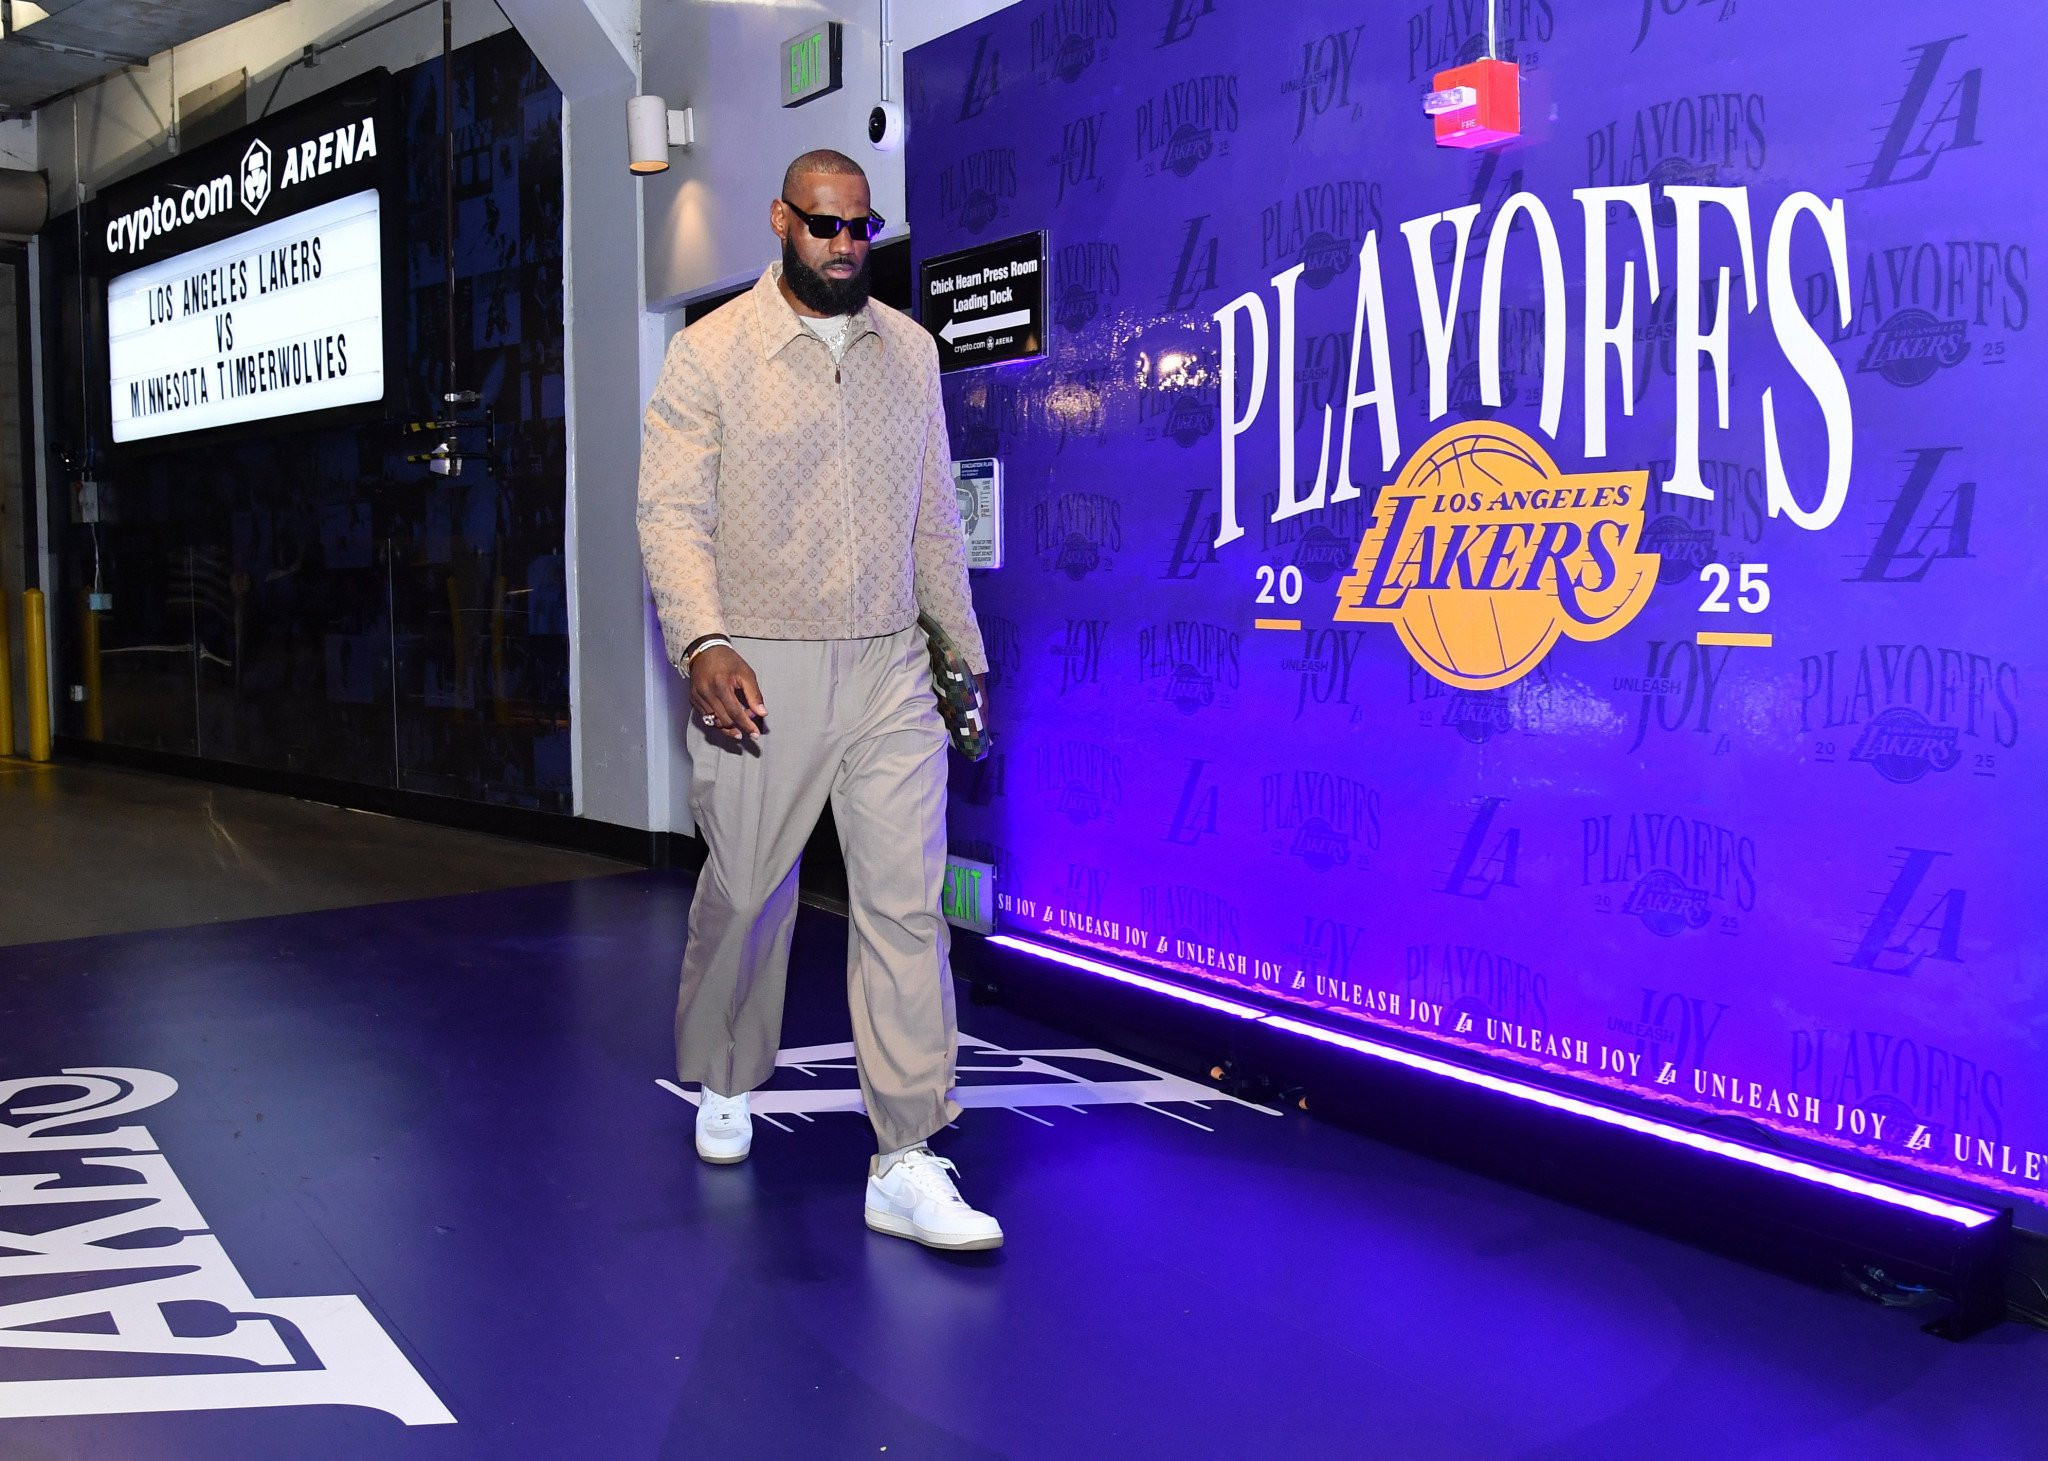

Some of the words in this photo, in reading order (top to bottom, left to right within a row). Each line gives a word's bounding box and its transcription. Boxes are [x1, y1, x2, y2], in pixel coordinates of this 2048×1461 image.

[790, 32, 821, 95] EXIT
[1291, 25, 1366, 145] JOY
[1136, 74, 1240, 162] PLAYOFFS
[1461, 118, 1477, 130] FIRE
[1846, 33, 1985, 193] LA
[107, 174, 233, 254] crypto.com
[280, 117, 377, 190] ARENA
[149, 284, 173, 326] LOS
[183, 260, 248, 317] ANGELES
[259, 236, 322, 295] LAKERS
[930, 277, 955, 296] Chick
[955, 272, 982, 290] Hearn
[983, 266, 1009, 284] Press
[1010, 259, 1038, 278] Room
[953, 294, 989, 314] Loading
[990, 286, 1013, 306] Dock
[1157, 214, 1220, 316] LA
[215, 311, 233, 353] VS
[954, 341, 986, 354] crypto.com
[995, 336, 1013, 346] ARENA
[1213, 182, 1854, 549] PLAYOFFS
[1864, 329, 1962, 368] LAKERS
[1983, 341, 2005, 357] 25
[130, 366, 209, 418] MINNESOTA
[217, 333, 347, 400] TIMBERWOLVES
[1158, 488, 1220, 580] LA
[1432, 492, 1484, 514] LOS
[1487, 485, 1632, 512] ANGELES
[1841, 446, 1978, 584] LA
[1255, 565, 1303, 605] 20
[1348, 496, 1644, 625] LAKERS
[1698, 563, 1771, 613] 25
[1138, 620, 1242, 692] PLAYOFFS
[1281, 657, 1330, 674] UNLEASH
[1292, 627, 1367, 724] JOY
[1613, 676, 1682, 695] UNLEASH
[1627, 639, 1736, 756] JOY
[1799, 644, 2020, 749] PLAYOFFS
[1814, 741, 1836, 754] 20
[1862, 725, 1953, 761] LAKERS
[1974, 754, 1996, 768] 25
[1159, 758, 1221, 846] LA
[1261, 769, 1382, 851] PLAYOFFS
[1431, 794, 1522, 901] LA
[1580, 812, 1757, 913] PLAYOFFS
[943, 863, 982, 924] EXIT
[1627, 885, 1707, 921] LAKERS
[1721, 915, 1739, 930] 25
[1831, 846, 1967, 979] LA
[1016, 898, 1037, 919] JOY
[1060, 909, 1120, 941] UNLEASH
[1126, 926, 1149, 949] JOY
[1177, 940, 1247, 975] UNLEASH
[1254, 959, 1283, 985] JOY
[1316, 975, 1401, 1016] UNLEASH
[1410, 999, 1443, 1027] JOY
[1486, 1018, 1589, 1065] UNLEASH
[1600, 1045, 1642, 1077] JOY
[1694, 1069, 1821, 1125] UNLEASH
[1836, 1104, 1887, 1141] JOY
[1954, 1132, 2048, 1182] UNLE
[1607, 1016, 1675, 1044] UNLEASH
